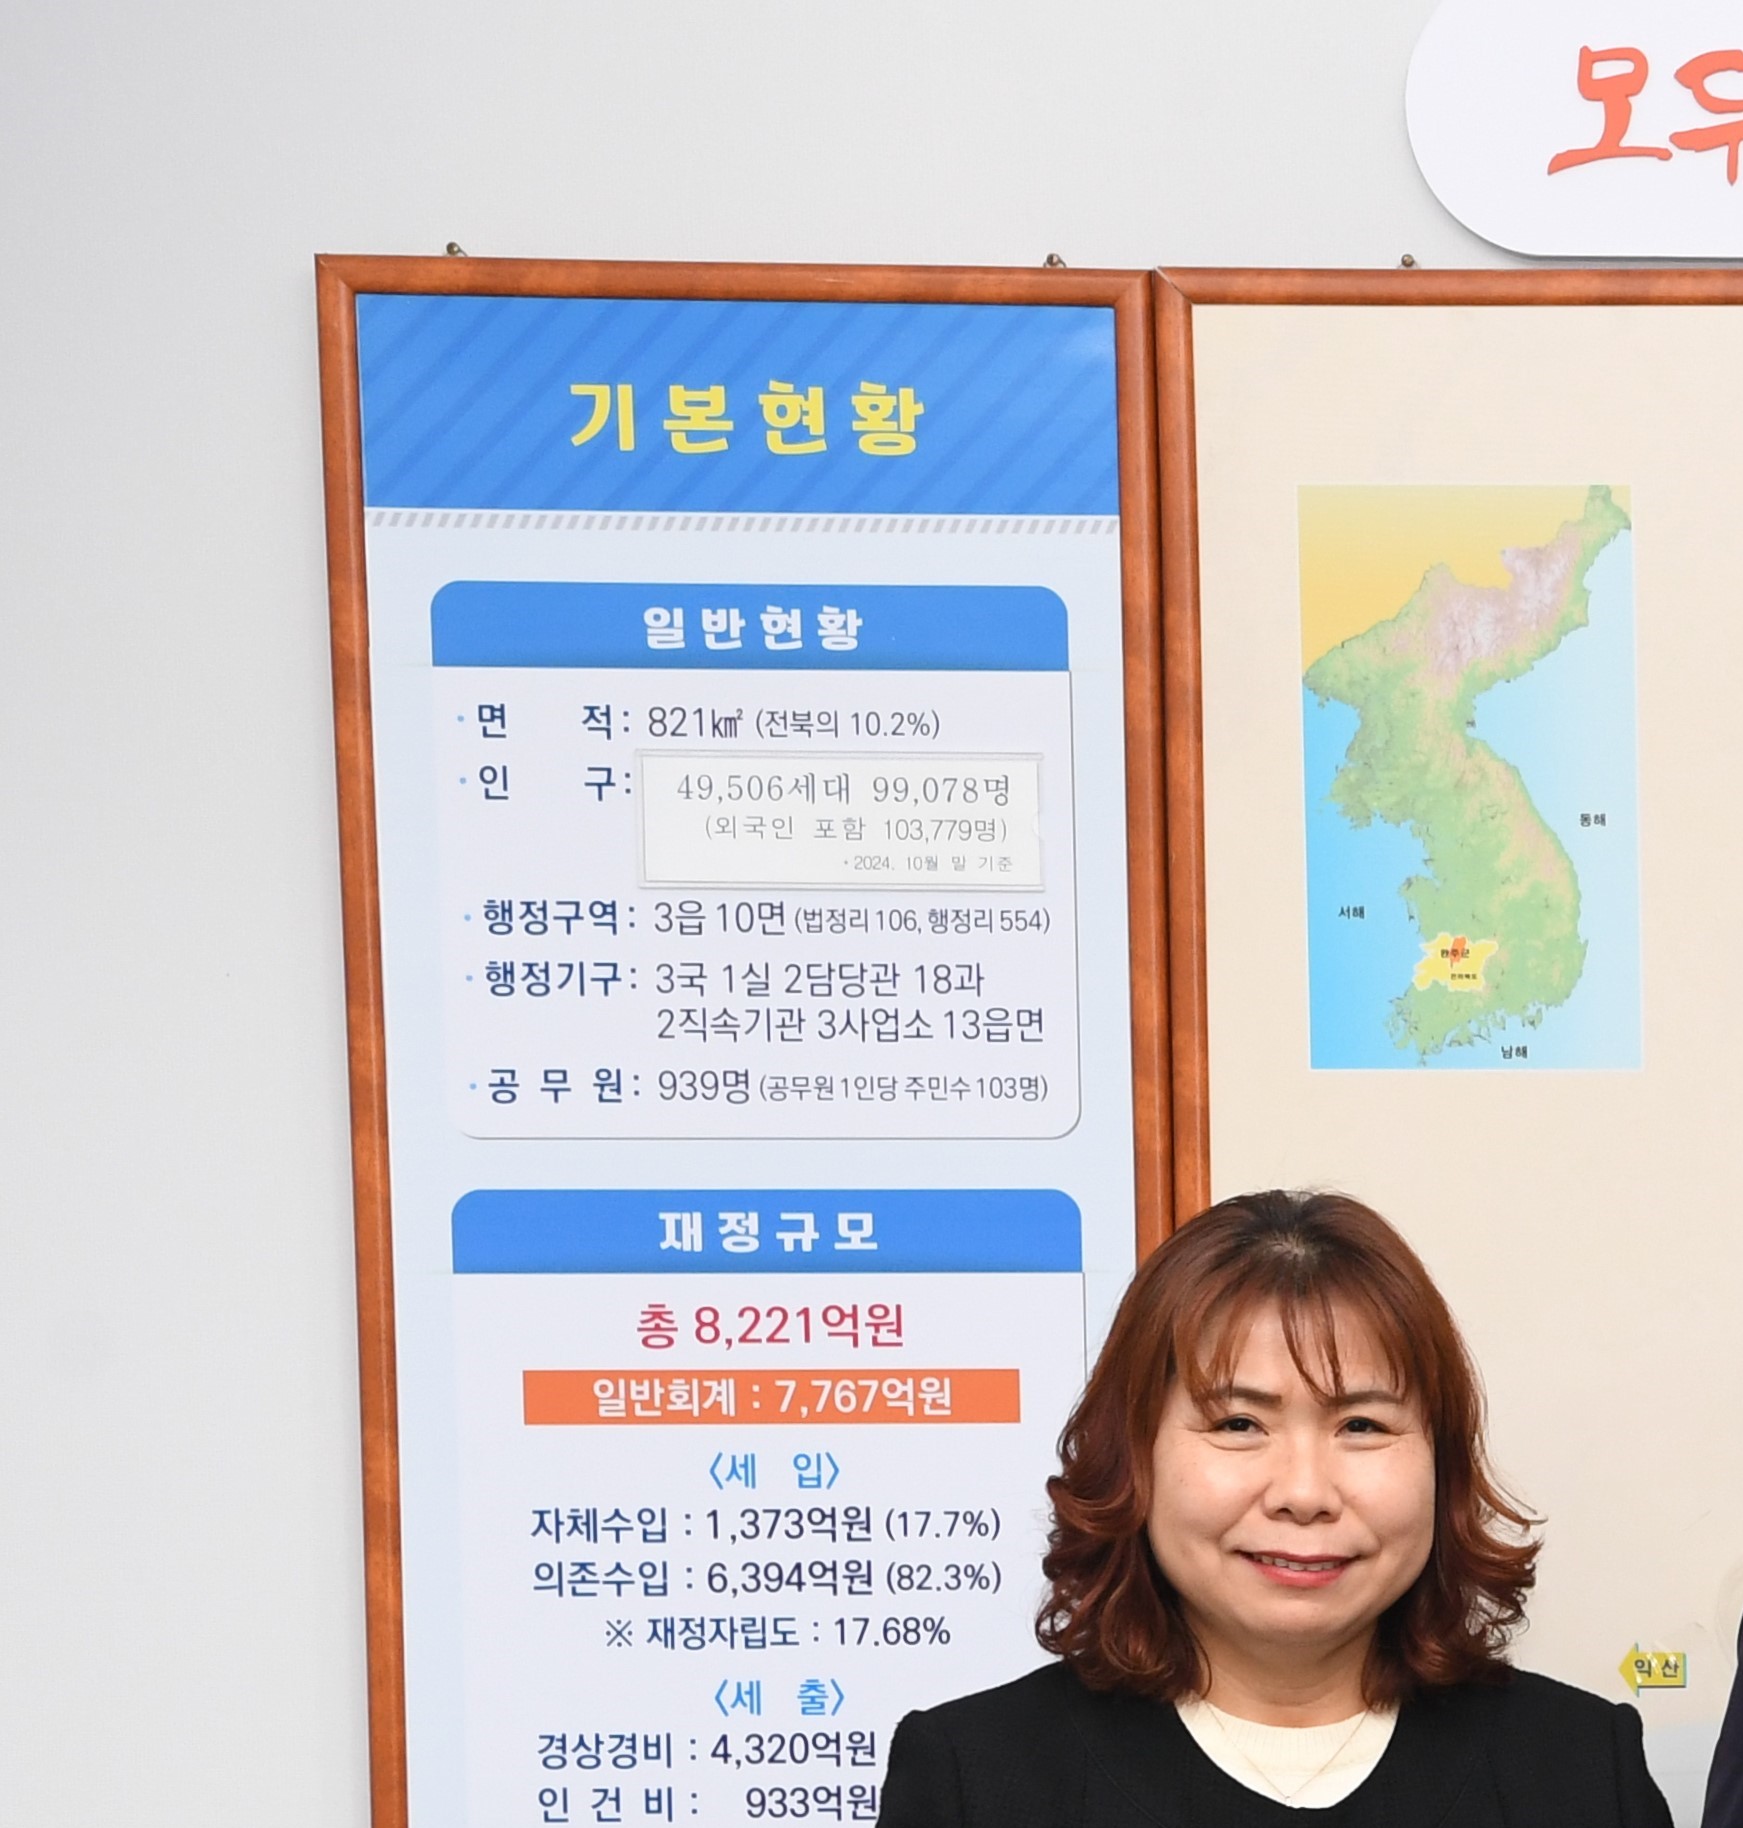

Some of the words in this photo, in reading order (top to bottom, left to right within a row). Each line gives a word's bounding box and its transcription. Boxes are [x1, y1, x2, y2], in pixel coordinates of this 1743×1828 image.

[756, 709, 838, 738] (전북의
[851, 710, 939, 739] 10.2%)
[677, 773, 849, 805] 49,506세대
[873, 775, 1008, 806] 99,078명
[706, 816, 792, 839] (외국인
[814, 817, 866, 840] 포함
[885, 818, 1006, 844] 103,779명)
[1580, 814, 1606, 827] 동해
[655, 900, 706, 935] 3읍
[717, 901, 785, 935] 10면
[795, 907, 868, 934] (법정리
[876, 909, 921, 934] 106,
[928, 909, 992, 934] 행정리
[1001, 908, 1050, 934] 554)
[1339, 906, 1364, 919] 서해
[656, 963, 707, 997] 3국
[723, 962, 769, 997] 1실
[785, 962, 900, 998] 2담당관
[915, 963, 984, 997] 18과
[658, 1008, 806, 1042] 2직속기관
[818, 1008, 933, 1042] 3사업소
[944, 1008, 1043, 1042] 13읍면
[1501, 1046, 1527, 1059] 남해
[659, 1069, 749, 1104] 939명
[637, 1304, 678, 1349] 총
[695, 1304, 903, 1350] 8,221억원
[594, 1378, 735, 1417] 일반회계
[775, 1377, 951, 1418] 7,767억원
[531, 1508, 666, 1544] 자체수입
[707, 1506, 871, 1544] 1,373억원
[886, 1508, 1000, 1541] (17.7%)
[534, 1561, 667, 1597] 의존수입
[708, 1560, 872, 1597] 6,394억원
[887, 1561, 1001, 1594] (82.3%)
[647, 1616, 799, 1650] 재정자립도
[835, 1617, 950, 1646] 17.68%
[538, 1733, 671, 1770] 경상경비
[711, 1731, 875, 1769] 4,320억원
[746, 1786, 877, 1821] 933억원
